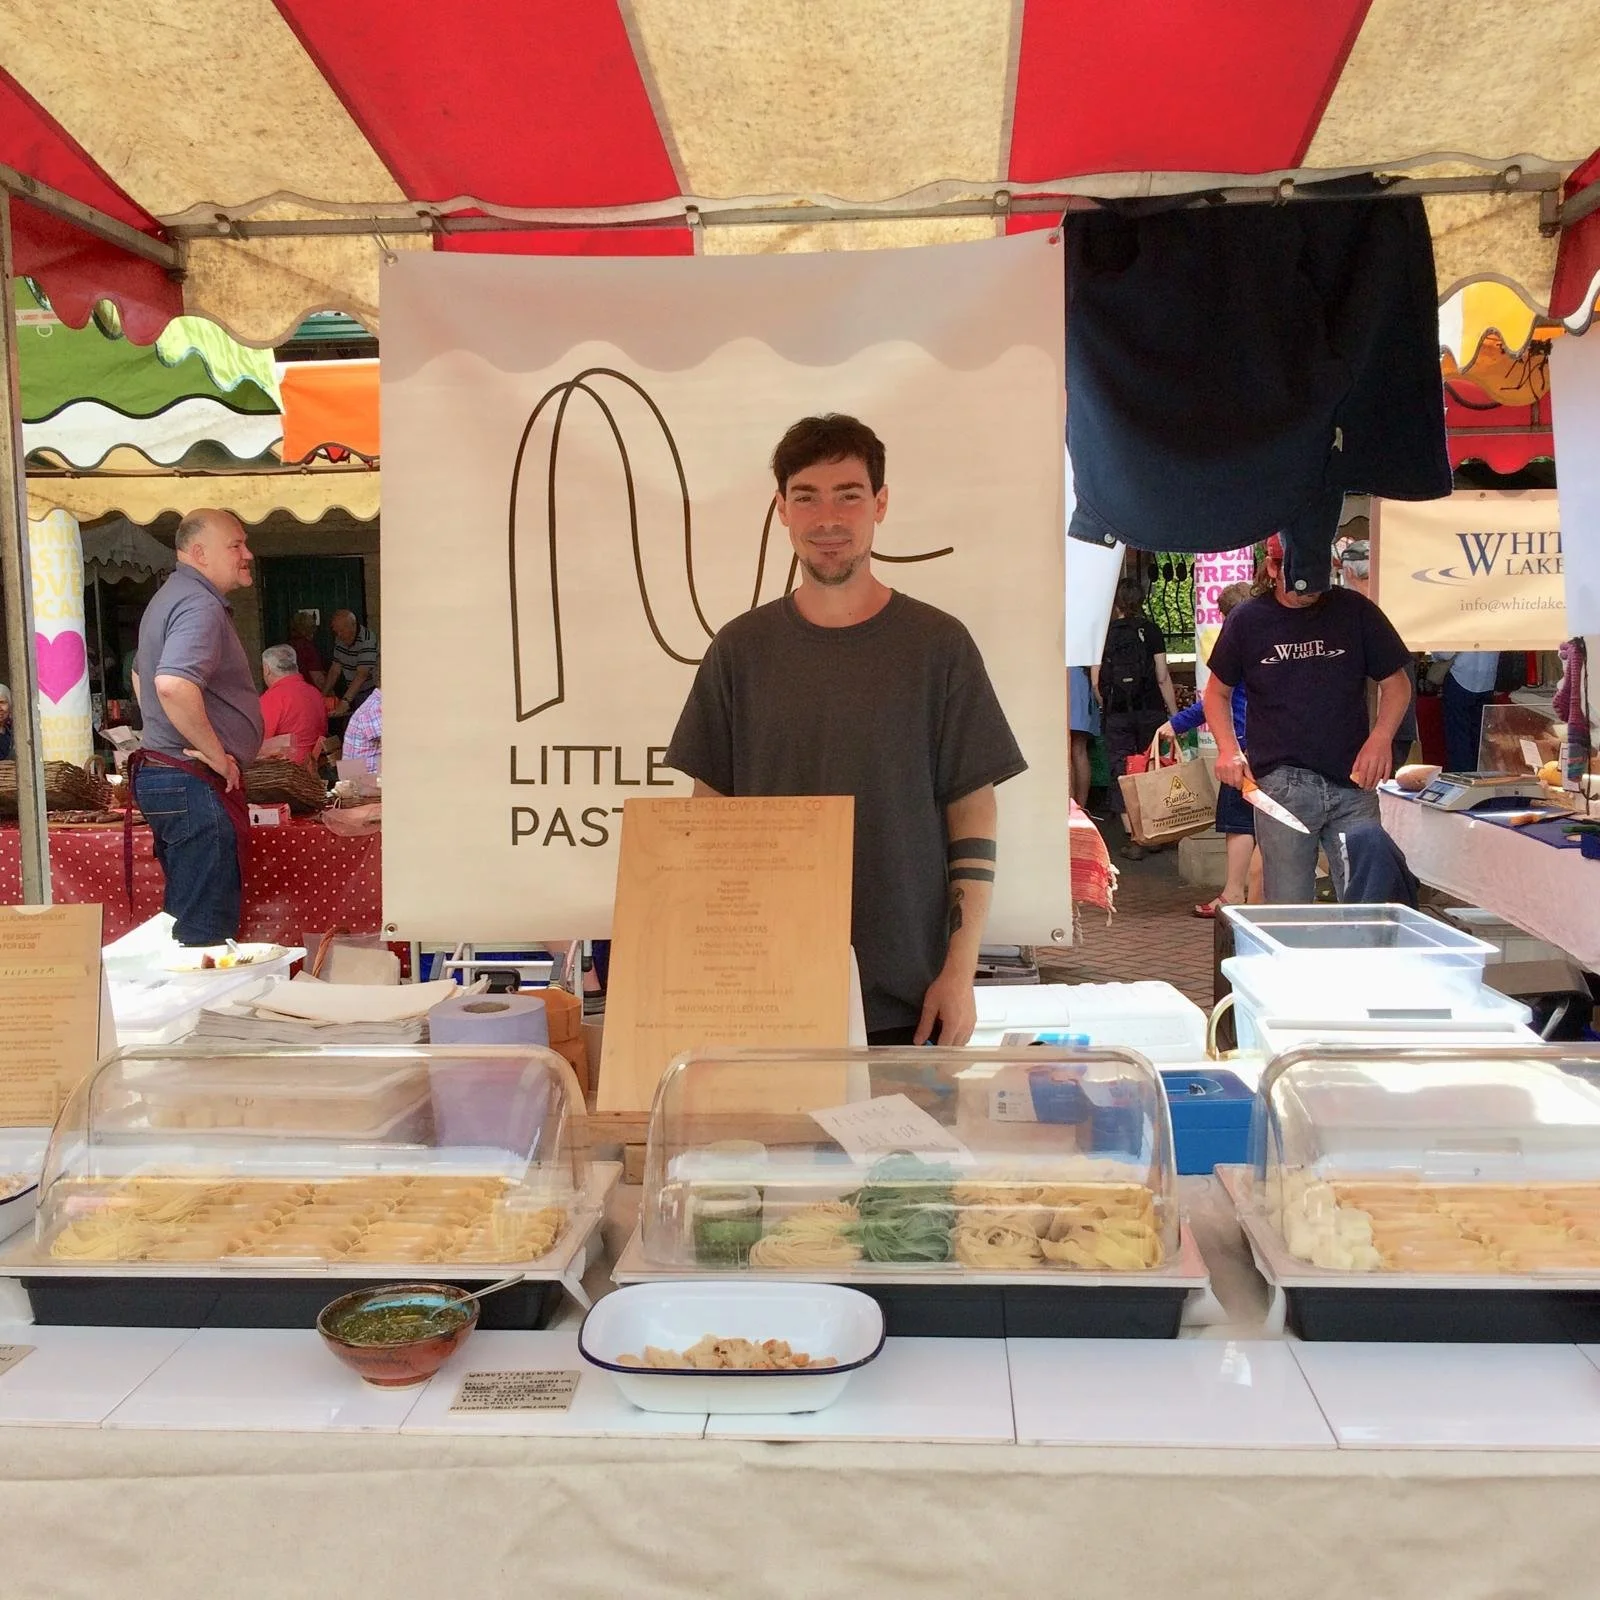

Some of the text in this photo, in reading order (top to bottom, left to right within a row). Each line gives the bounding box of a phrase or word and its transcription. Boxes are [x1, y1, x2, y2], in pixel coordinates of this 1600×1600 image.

[1455, 531, 1563, 577] WHIT
[1460, 597, 1566, 613] info@whitelake.
[1196, 607, 1223, 625] DR
[1274, 640, 1326, 661] WHITE
[1293, 650, 1315, 659] LAKE
[510, 745, 675, 786] LITTLE
[651, 801, 690, 813] LITTLE
